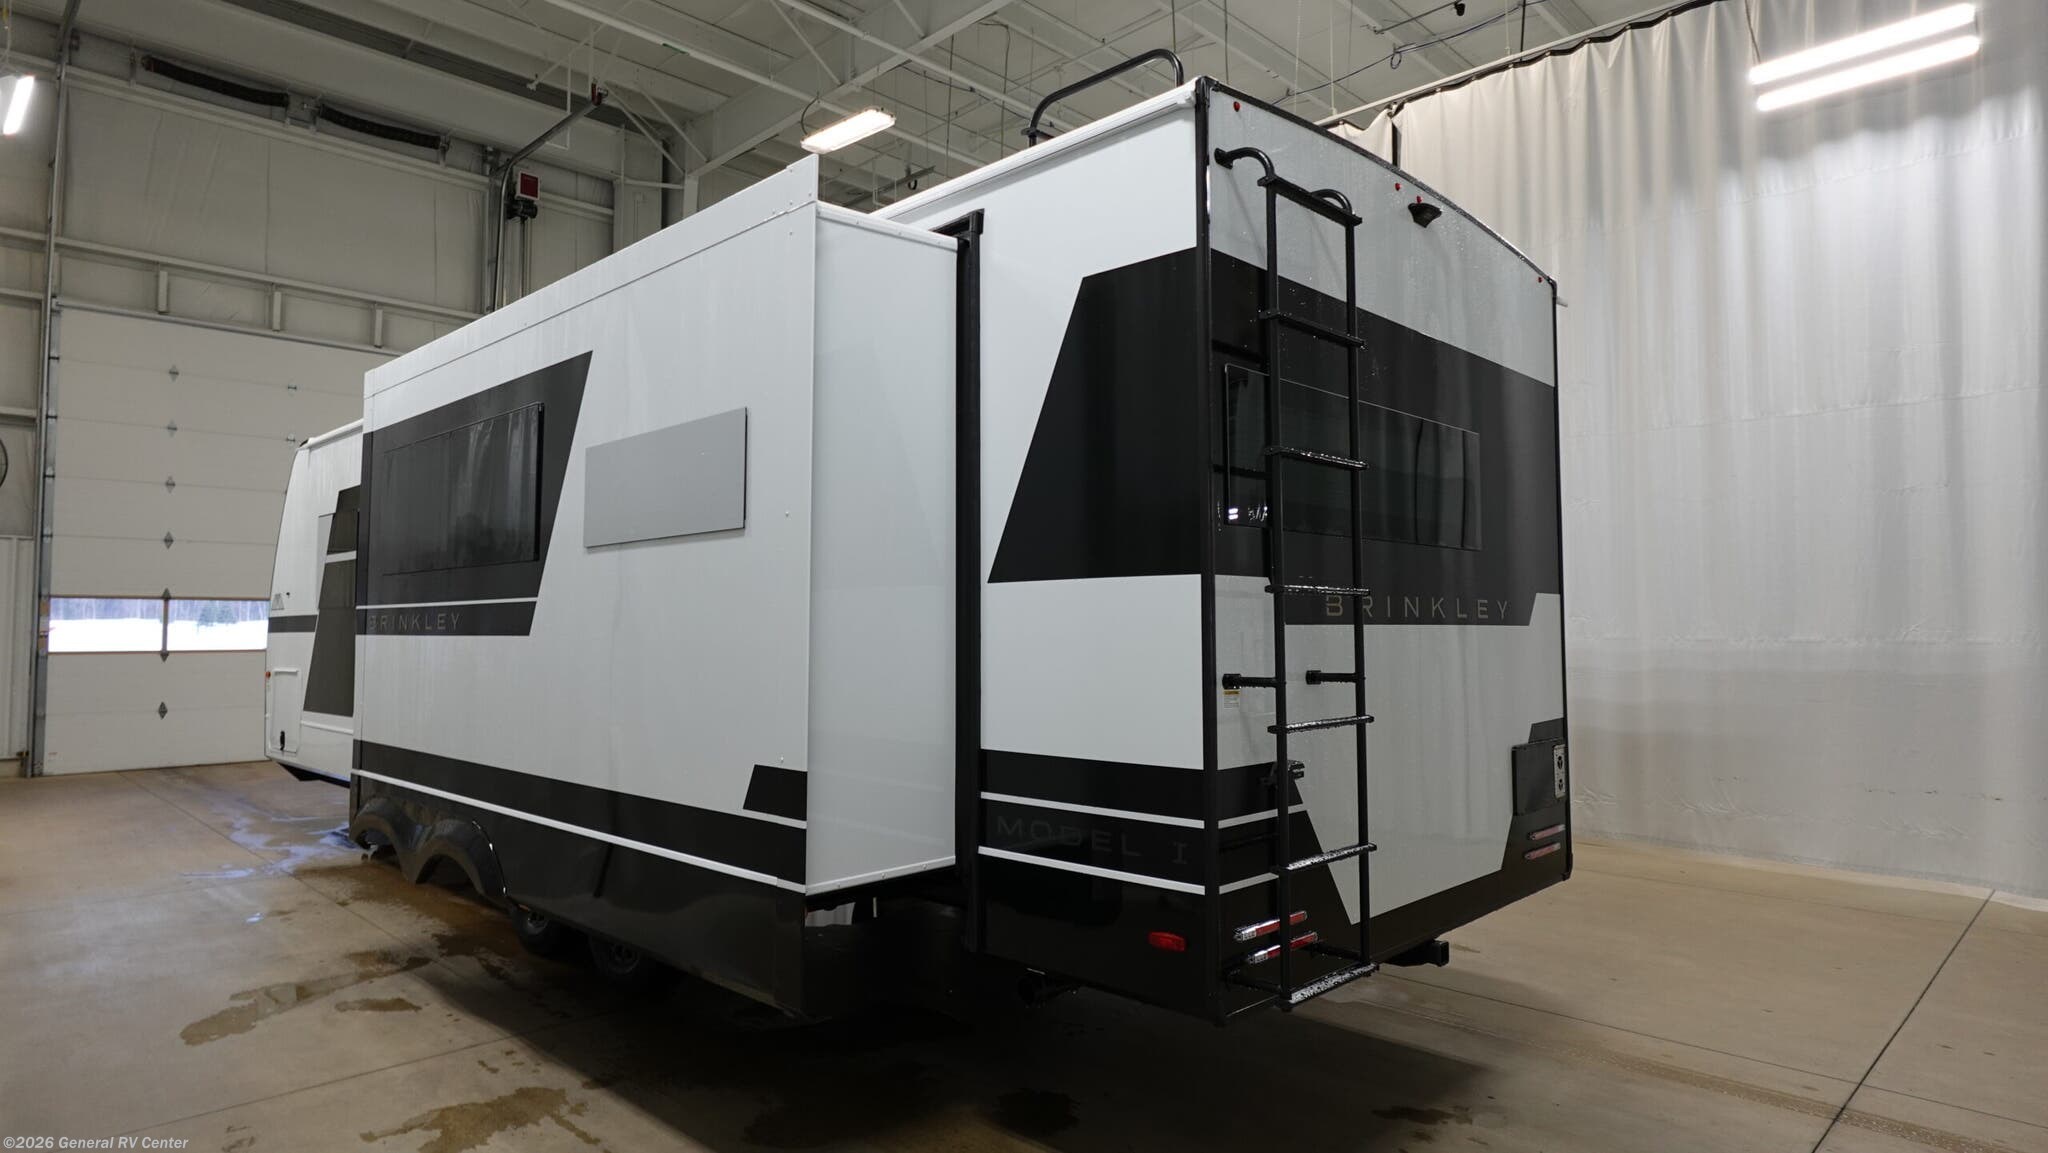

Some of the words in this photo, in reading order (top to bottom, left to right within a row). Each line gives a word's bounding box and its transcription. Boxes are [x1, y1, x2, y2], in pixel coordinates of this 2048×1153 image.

[1325, 594, 1509, 621] BRINKLEY
[367, 612, 461, 632] BRINKLEY
[996, 815, 1143, 857] MODEL
